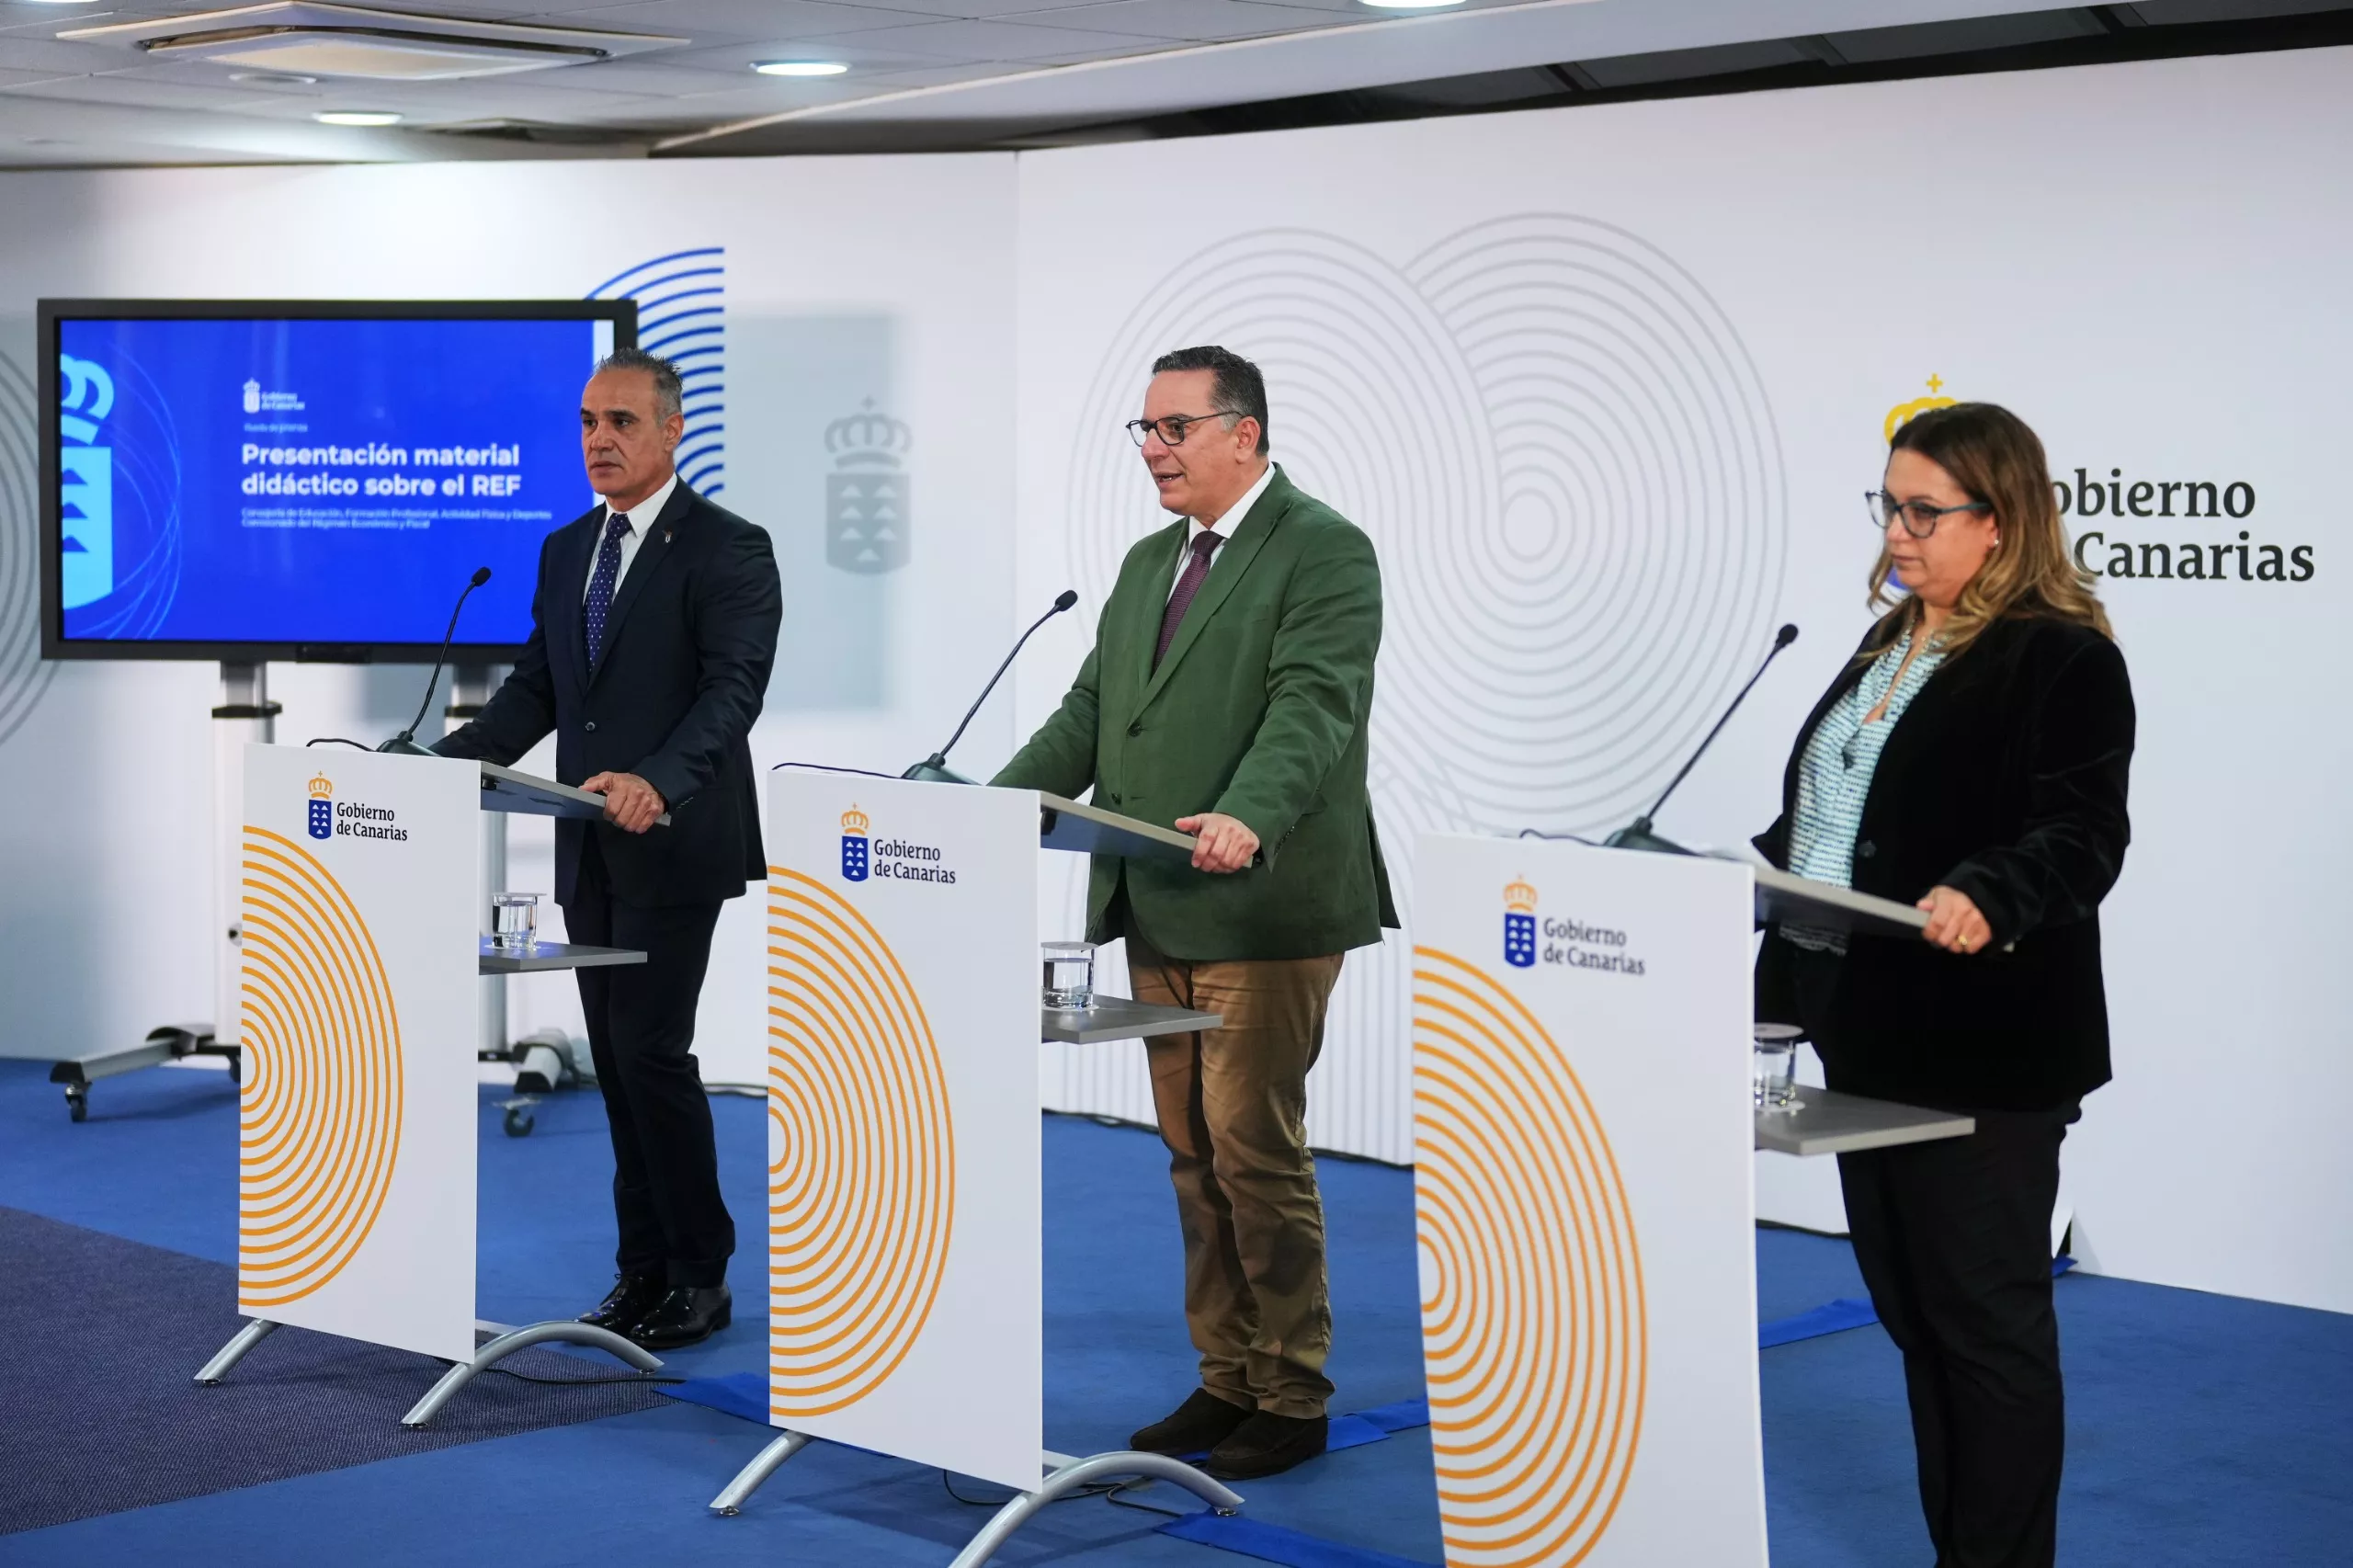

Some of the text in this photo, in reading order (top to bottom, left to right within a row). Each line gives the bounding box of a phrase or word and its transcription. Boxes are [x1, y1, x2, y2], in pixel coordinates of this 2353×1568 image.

[242, 442, 519, 466] Presentación material
[242, 472, 522, 496] didáctico sobre el REF
[2074, 531, 2315, 582] Canarias
[336, 801, 395, 822] Gobierno
[336, 820, 408, 841] de Canarias
[874, 838, 940, 861] Gobierno
[874, 859, 956, 884] de Canarias
[1542, 917, 1627, 948] Gobierno
[1542, 942, 1645, 976] de Canarias
